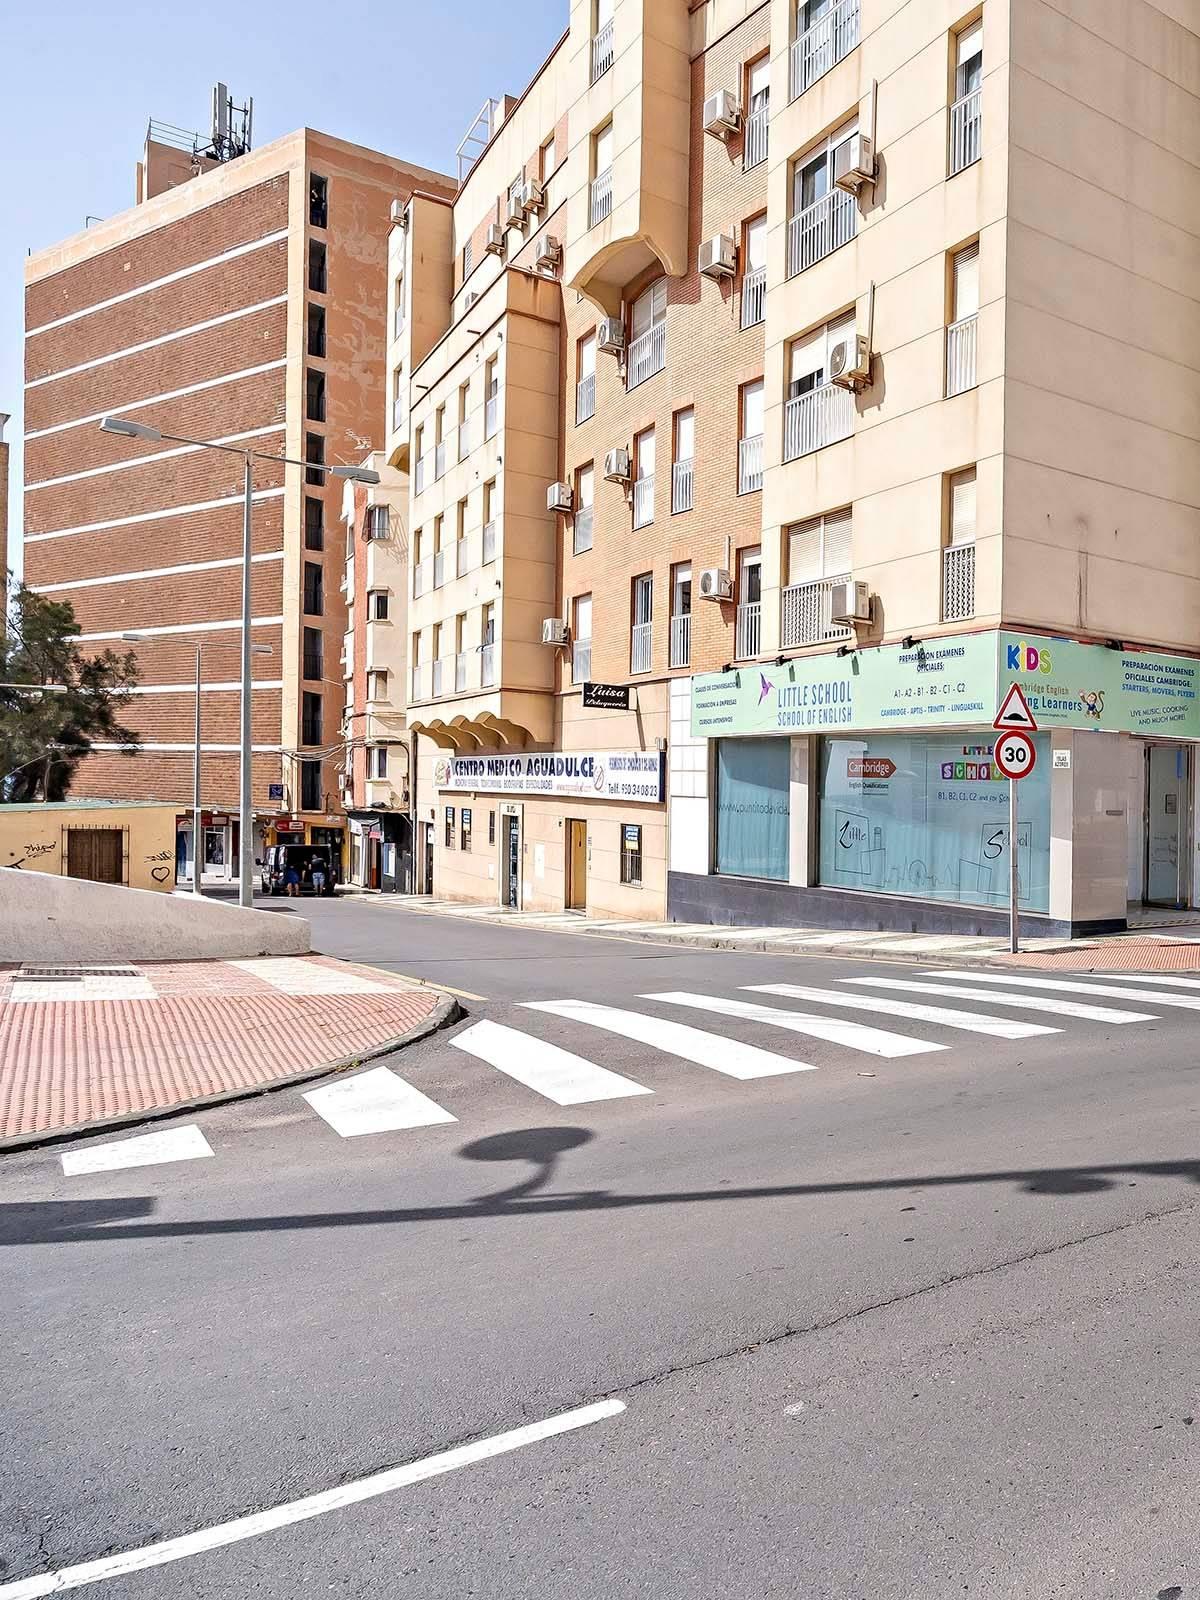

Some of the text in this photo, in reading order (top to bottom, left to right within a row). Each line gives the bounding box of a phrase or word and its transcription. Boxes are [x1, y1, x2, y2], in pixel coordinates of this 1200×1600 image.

[1124, 672, 1155, 684] OFICIALES
[586, 684, 626, 698] Luisa
[778, 681, 852, 708] LITTLE SCHOOL
[930, 685, 937, 695] B2
[942, 684, 951, 694] C1
[957, 683, 966, 693] C2
[1046, 684, 1069, 696] English
[1042, 695, 1083, 712] Learners
[1162, 705, 1189, 714] COOKING
[777, 707, 852, 727] SCHOOL OF ENGLISH
[1138, 717, 1151, 726] AND
[962, 745, 993, 756] LITTLE
[1004, 746, 1027, 763] 30
[455, 757, 594, 778] CENTRO MEDICO AGUADULCE
[848, 760, 890, 776] Cambridge
[649, 785, 658, 797] 23
